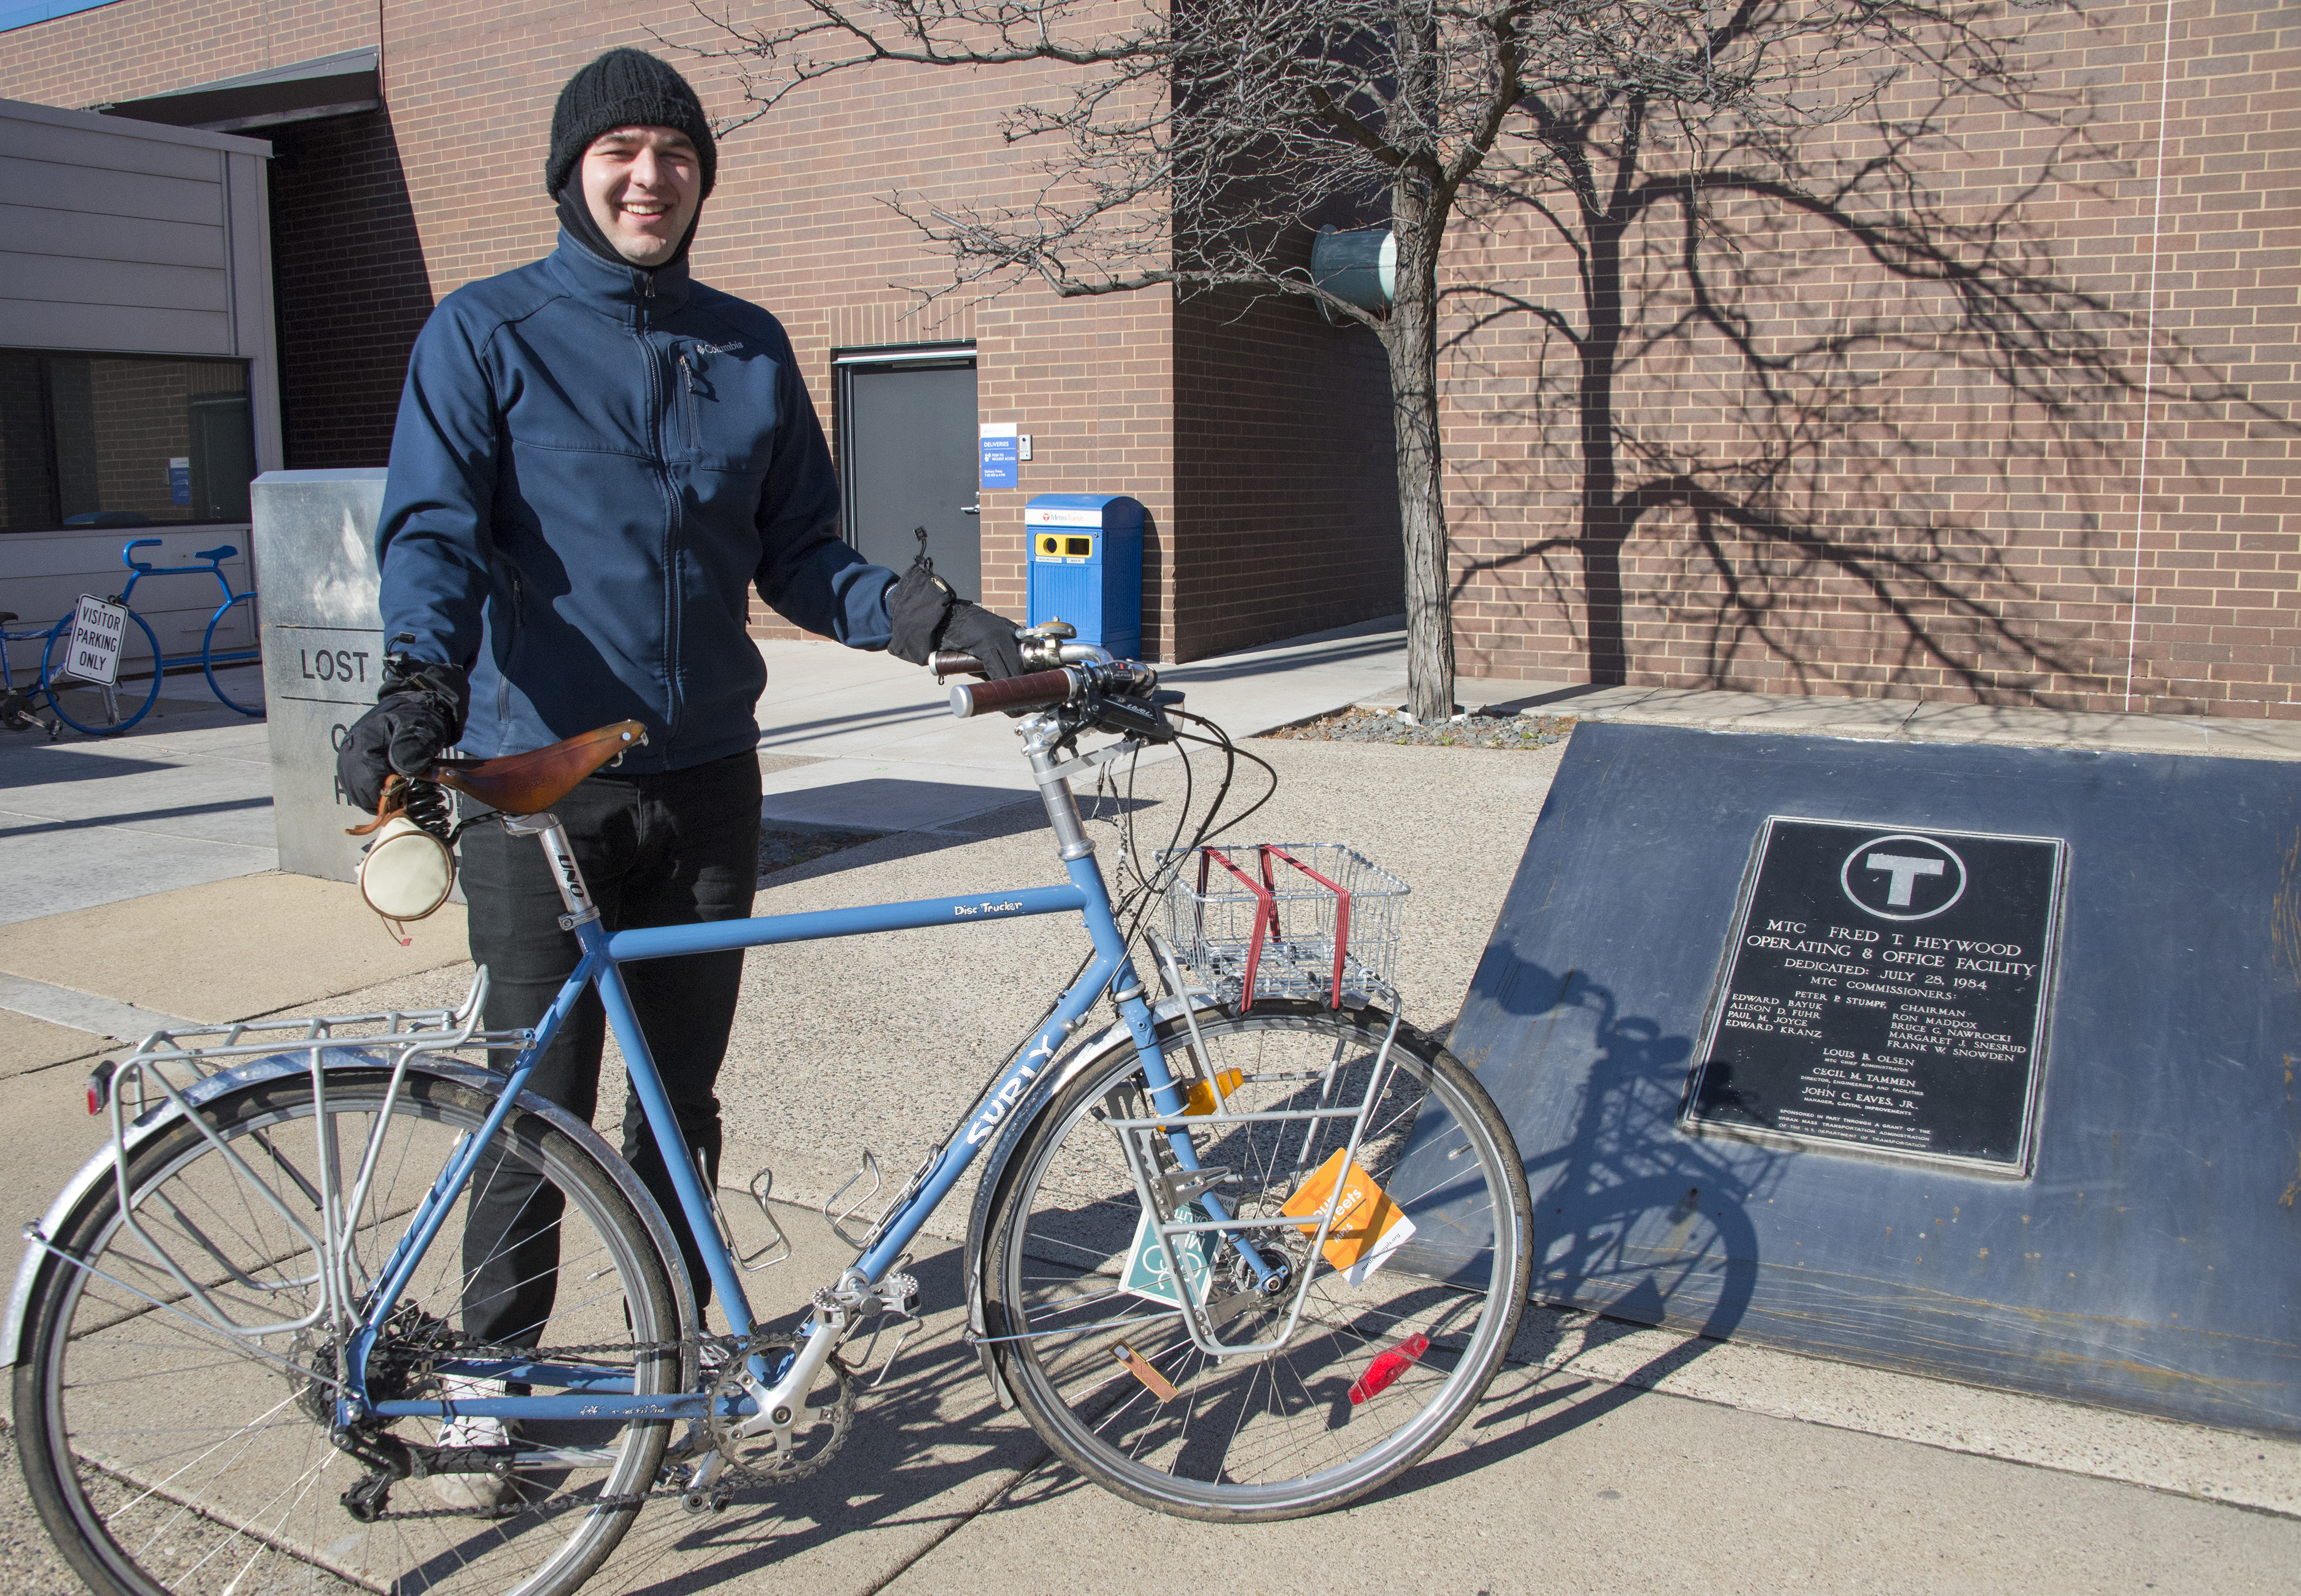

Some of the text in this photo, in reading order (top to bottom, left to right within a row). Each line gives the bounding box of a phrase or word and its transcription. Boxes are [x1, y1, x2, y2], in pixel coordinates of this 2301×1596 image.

[705, 341, 743, 353] Columbia
[82, 606, 121, 631] VISITOR
[76, 627, 117, 652] PARKING
[79, 651, 106, 671] ONLY
[301, 649, 369, 683] LOST
[557, 855, 584, 898] UNO
[954, 900, 1023, 916] Disc Trucker
[1766, 919, 2021, 956] MTC FRED T. HEYWOOD
[1746, 935, 2036, 975] OPERATING & OFFICE FACILITY
[1783, 958, 1987, 990] DEDICATED: JULY 28, 1984
[1810, 976, 1956, 1000] MTC COMMISSIONERS:
[1729, 1002, 1771, 1012] ALISON
[1792, 1009, 1820, 1019] FUHR
[1732, 993, 1822, 1010] EDWARD BAYUK
[1794, 990, 1827, 1000] PETER
[1845, 997, 1886, 1009] STUMPF,
[1900, 1004, 1966, 1017] CHAIRMAN
[1725, 1019, 1822, 1038] EDWARD KRANZ
[1727, 1011, 1751, 1019] PAUL
[1773, 1016, 1807, 1026] JOYCE
[1892, 1013, 1977, 1028] RON MADDOX
[1889, 1031, 1952, 1044] MARGARET
[1974, 1041, 2026, 1052] SNESRUD
[1890, 1021, 1926, 1032] BRUCE
[1947, 1028, 2010, 1042] NAWROCKI
[1822, 1047, 1855, 1058] LOUIS
[1876, 1055, 1914, 1066] OLSEN
[1887, 1040, 2014, 1061] FRANK W. SNOWDEN
[1812, 1067, 1916, 1087] CECIL M. TAMMEN
[1860, 1063, 1908, 1072] ADMINISTRATOR
[966, 1034, 1054, 1151] SURLY
[1800, 1075, 1830, 1083] DIRECTOR,
[1832, 1080, 1873, 1088] ENGINEERING
[1892, 1088, 1924, 1096] FACILITIES
[1802, 1086, 1836, 1097] JOHN
[1855, 1093, 1893, 1106] EAVES,
[1899, 1100, 1918, 1109] JR.
[1803, 1097, 1834, 1105] MANAGER,
[1864, 1105, 1912, 1115] IMPROVEMENTS
[1779, 1109, 1814, 1117] SPONSORED
[1843, 1117, 1871, 1126] THROUGH
[1817, 1129, 1856, 1138] DEPARTMENT
[1872, 1137, 1925, 1147] TRANSPORTATION
[1822, 1122, 1875, 1133] TRANSPORTATION
[1879, 1131, 1929, 1140] ADMINISTRATION
[1333, 1223, 1353, 1243] MPLS
[1361, 1233, 1401, 1272] ourstreempls.org
